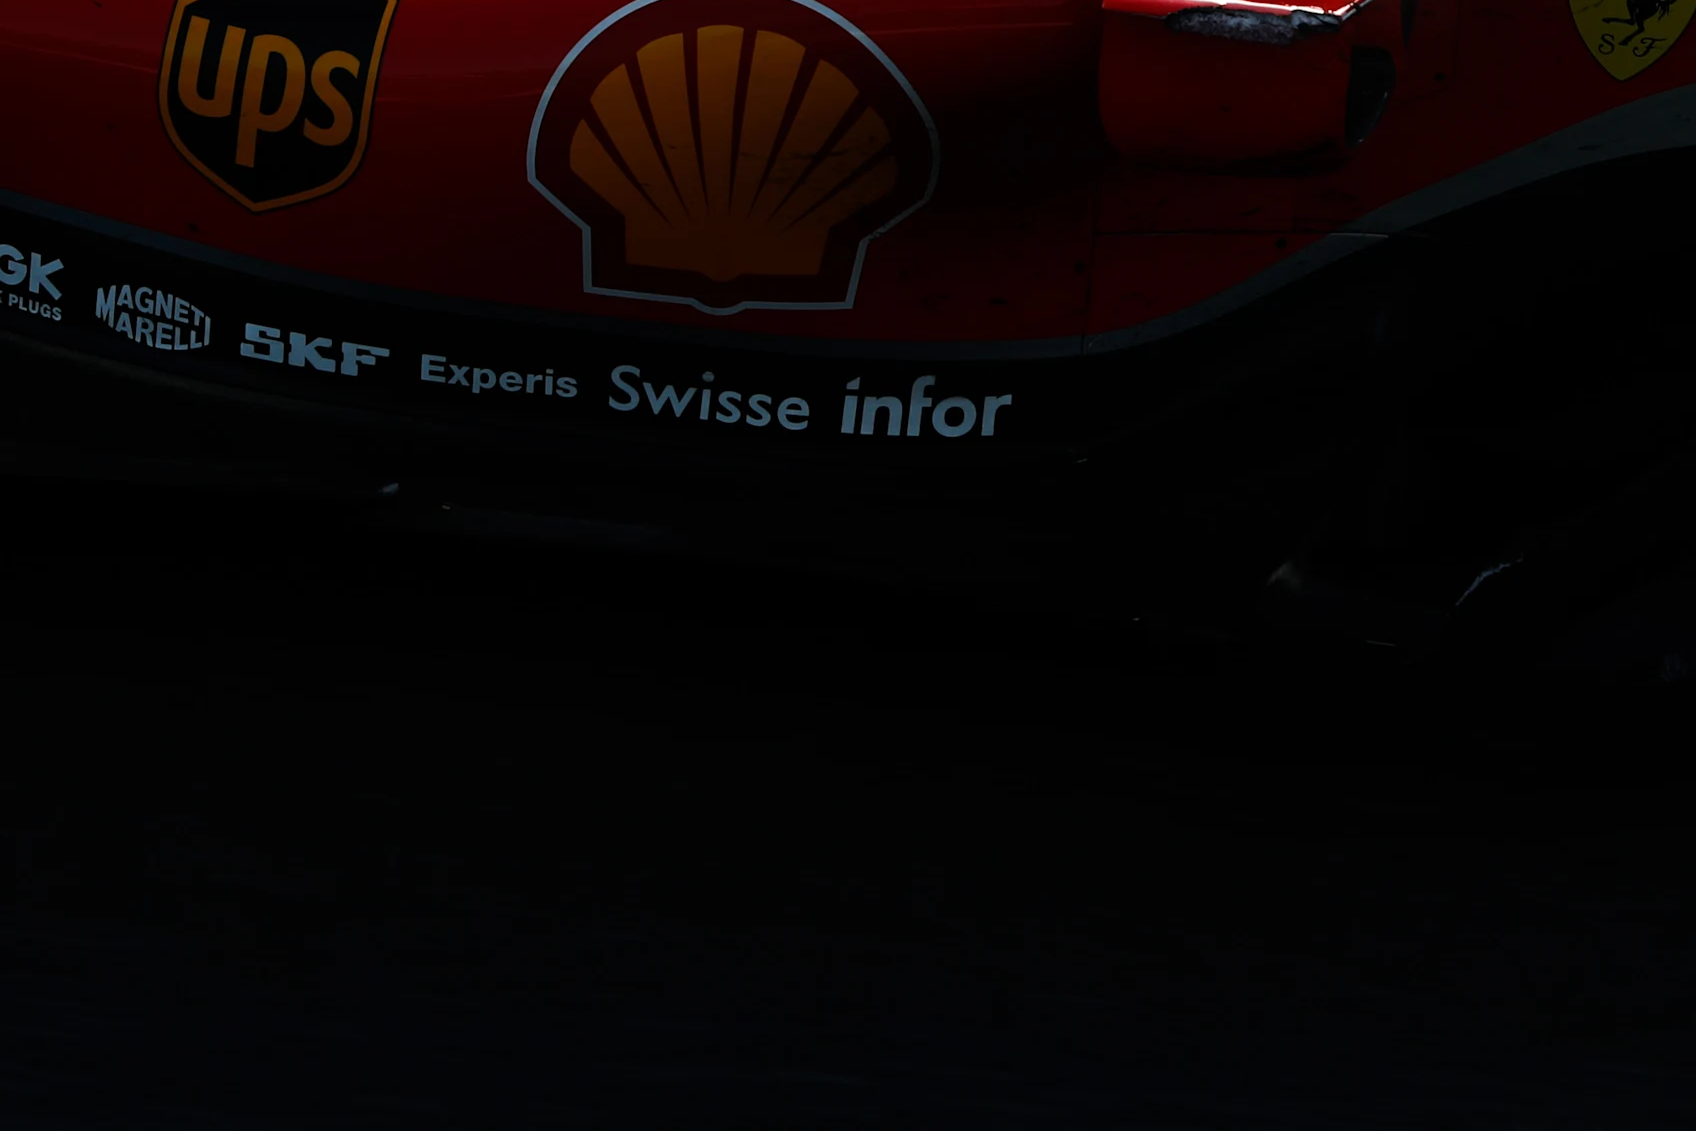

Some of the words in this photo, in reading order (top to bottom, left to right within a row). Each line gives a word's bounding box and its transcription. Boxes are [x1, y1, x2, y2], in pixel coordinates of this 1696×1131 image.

[1598, 33, 1615, 55] S
[177, 15, 361, 169] ups
[0, 243, 65, 302] GK
[8, 292, 63, 322] PLUGS
[95, 284, 212, 336] MAGNETI
[239, 323, 391, 378] SKF
[420, 354, 579, 399] Experis
[607, 365, 811, 432] Swisse
[840, 375, 1013, 439] infor
